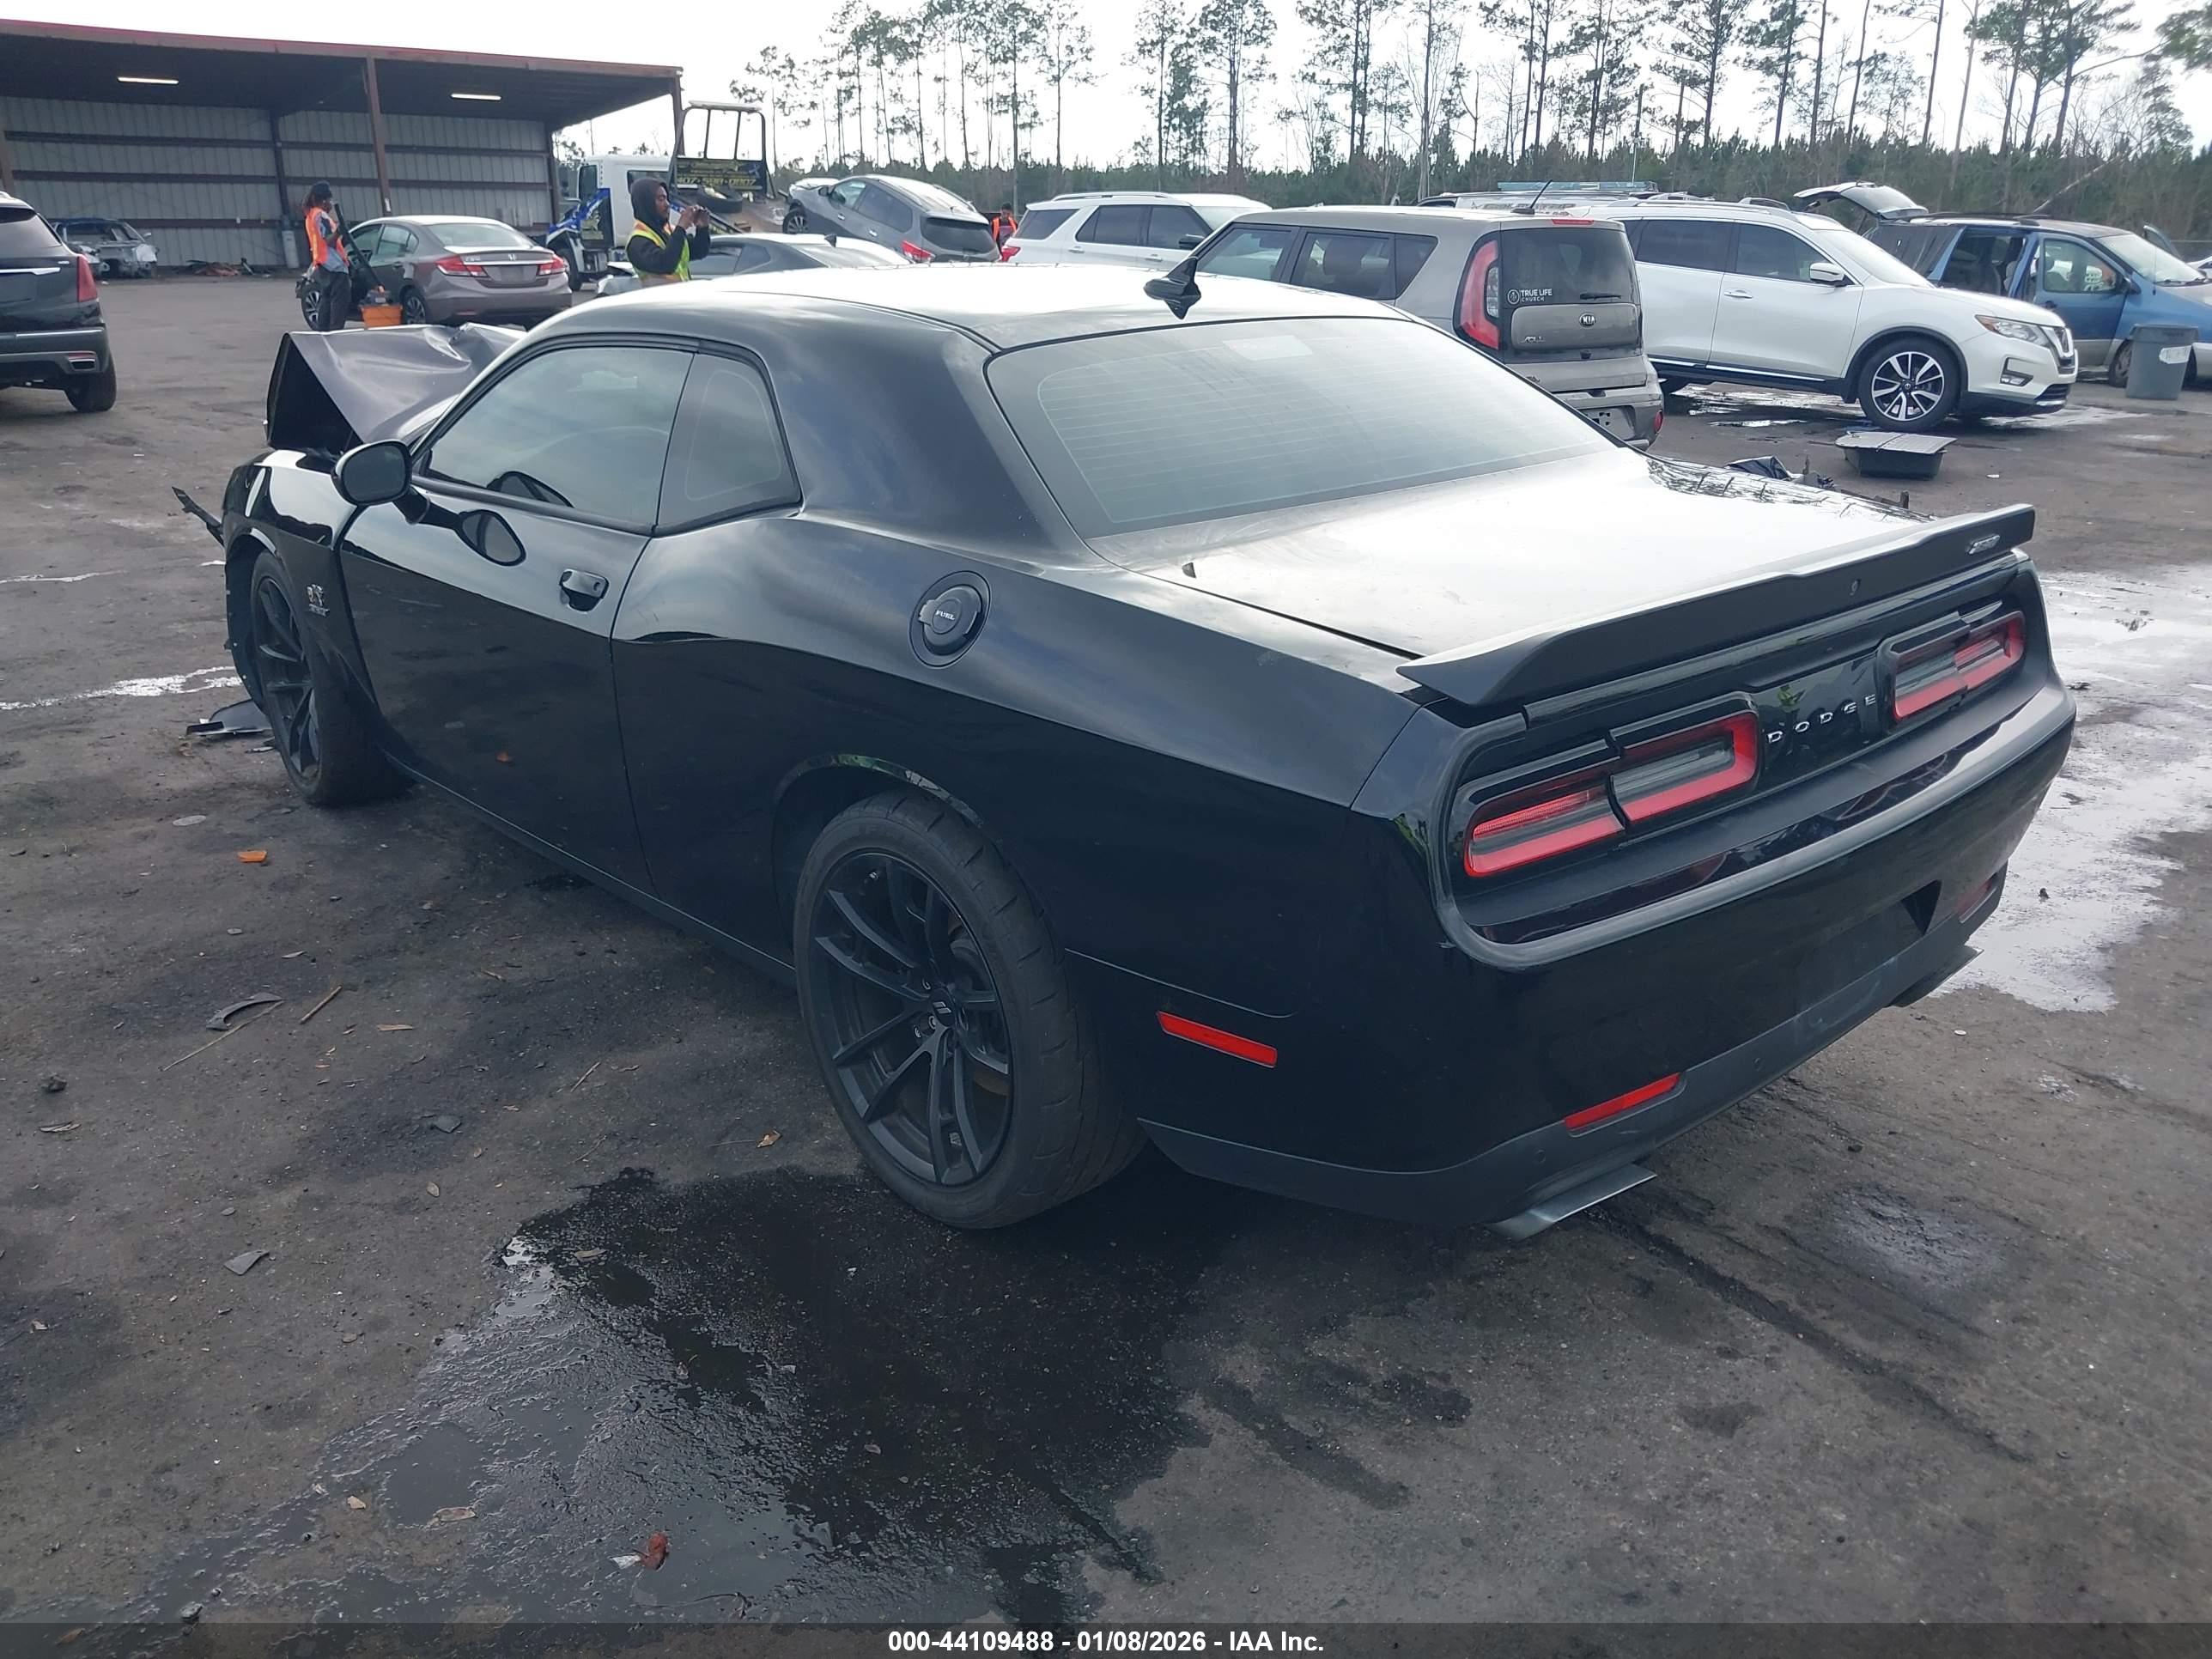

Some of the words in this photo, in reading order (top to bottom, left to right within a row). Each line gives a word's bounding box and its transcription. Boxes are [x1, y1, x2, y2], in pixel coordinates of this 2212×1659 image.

[1521, 289, 1538, 297] TRUE
[1539, 288, 1553, 296] LIFE
[935, 610, 956, 621] FUEL
[1767, 694, 1876, 744] DODGE
